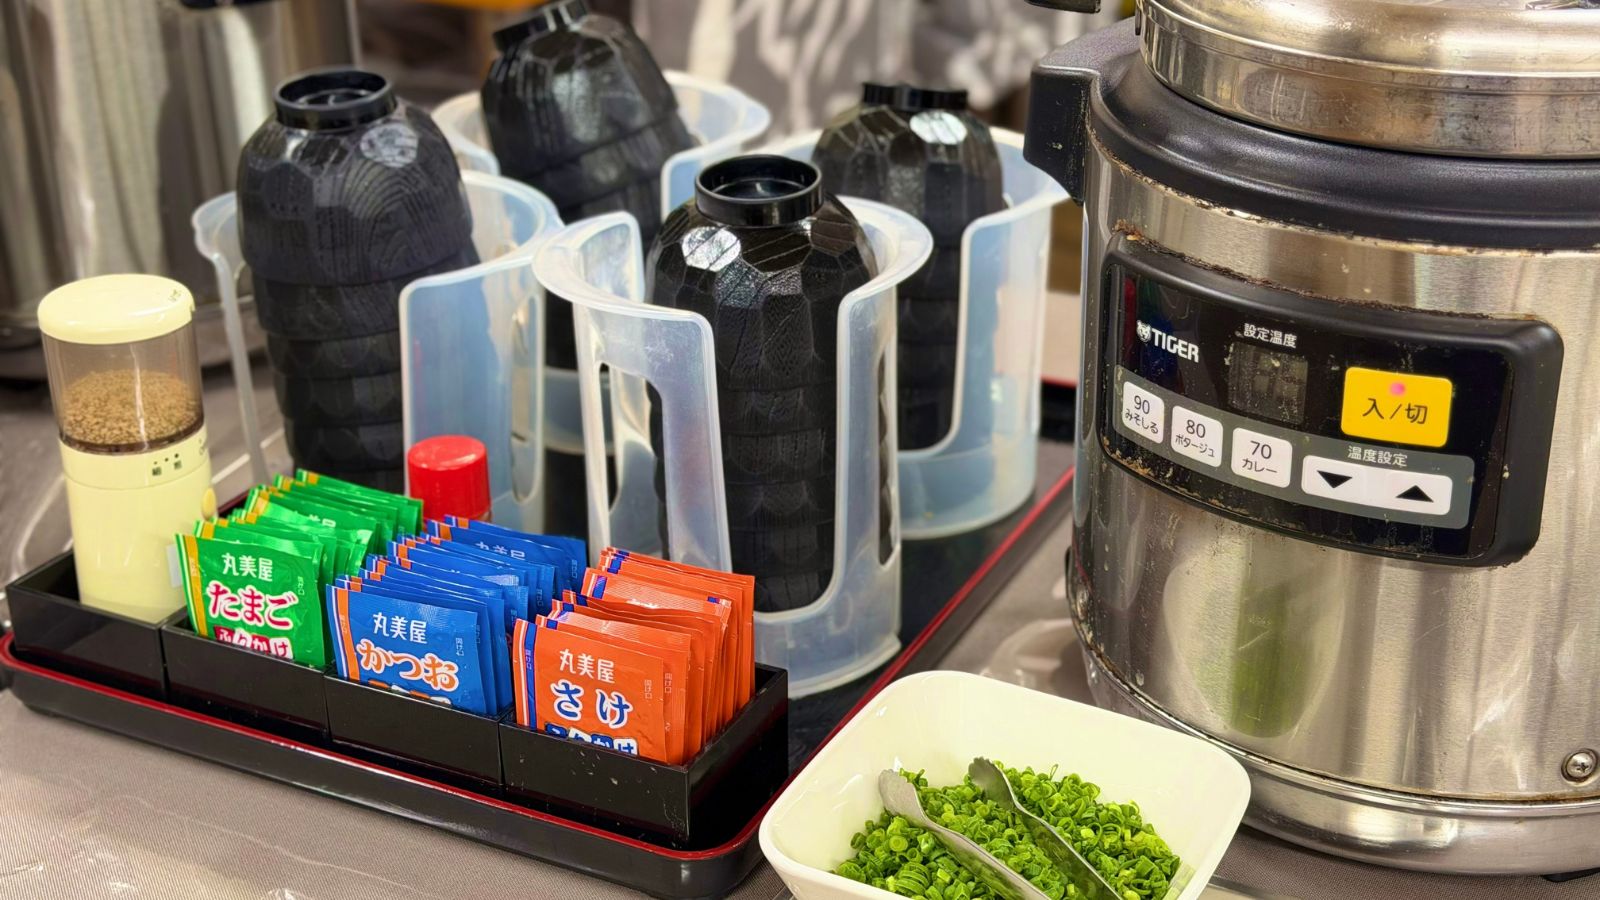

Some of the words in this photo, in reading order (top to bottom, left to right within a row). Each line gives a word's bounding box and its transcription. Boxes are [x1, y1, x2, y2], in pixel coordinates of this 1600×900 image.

[1151, 327, 1200, 363] TIGER
[1243, 323, 1298, 349] 設定温度
[1134, 395, 1150, 415] 90
[1125, 408, 1159, 434] みそしる
[1186, 419, 1206, 438] 80
[1250, 440, 1272, 460] 70
[1347, 445, 1408, 467] 温度設定
[1242, 457, 1278, 474] カレー
[221, 552, 273, 582] 丸美屋
[206, 580, 298, 629] たまご
[372, 612, 427, 644] 丸美屋
[356, 638, 459, 692] かつお
[559, 648, 615, 684] 丸美屋
[550, 679, 633, 729] さけ
